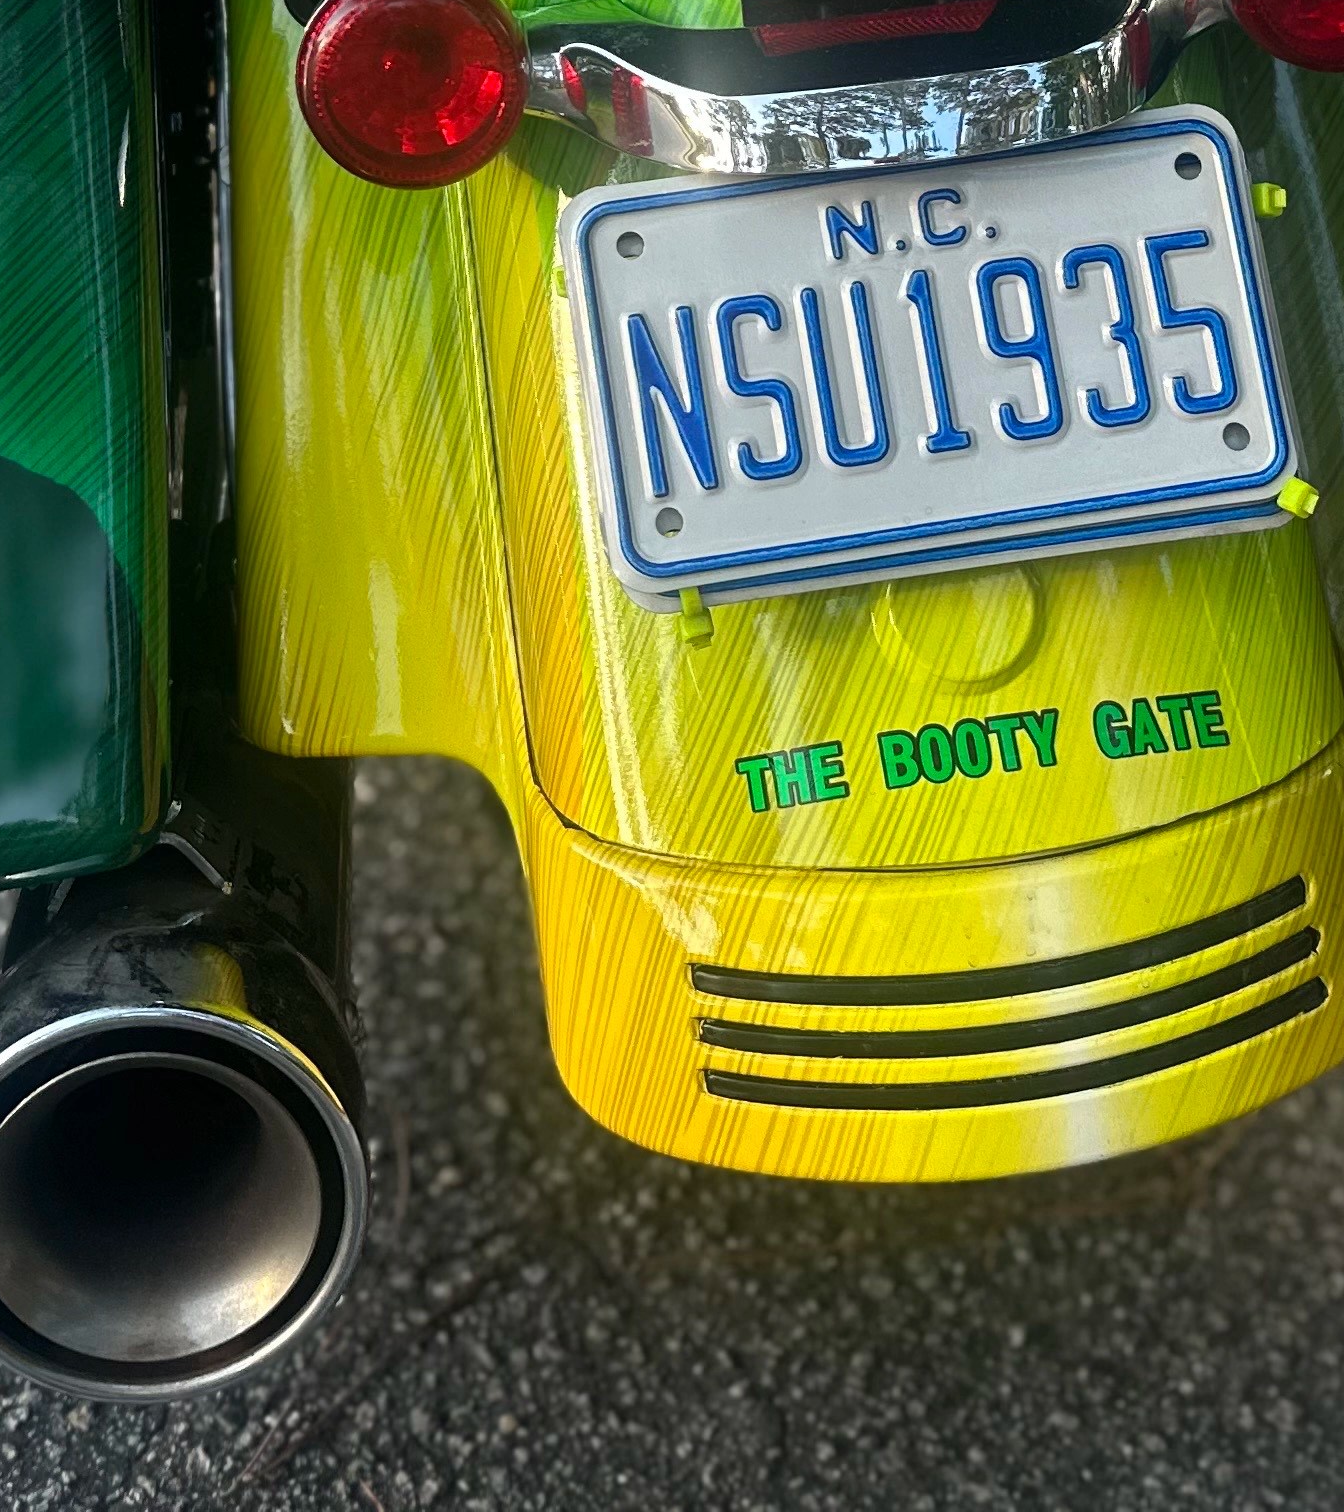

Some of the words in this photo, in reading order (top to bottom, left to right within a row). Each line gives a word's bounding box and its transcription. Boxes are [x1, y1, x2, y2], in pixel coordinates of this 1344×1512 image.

[824, 186, 1000, 262] N.C.
[626, 228, 1239, 500] NSU1935
[735, 740, 850, 813] THE
[877, 708, 1059, 790] BOOTY
[1092, 690, 1230, 758] GATE
